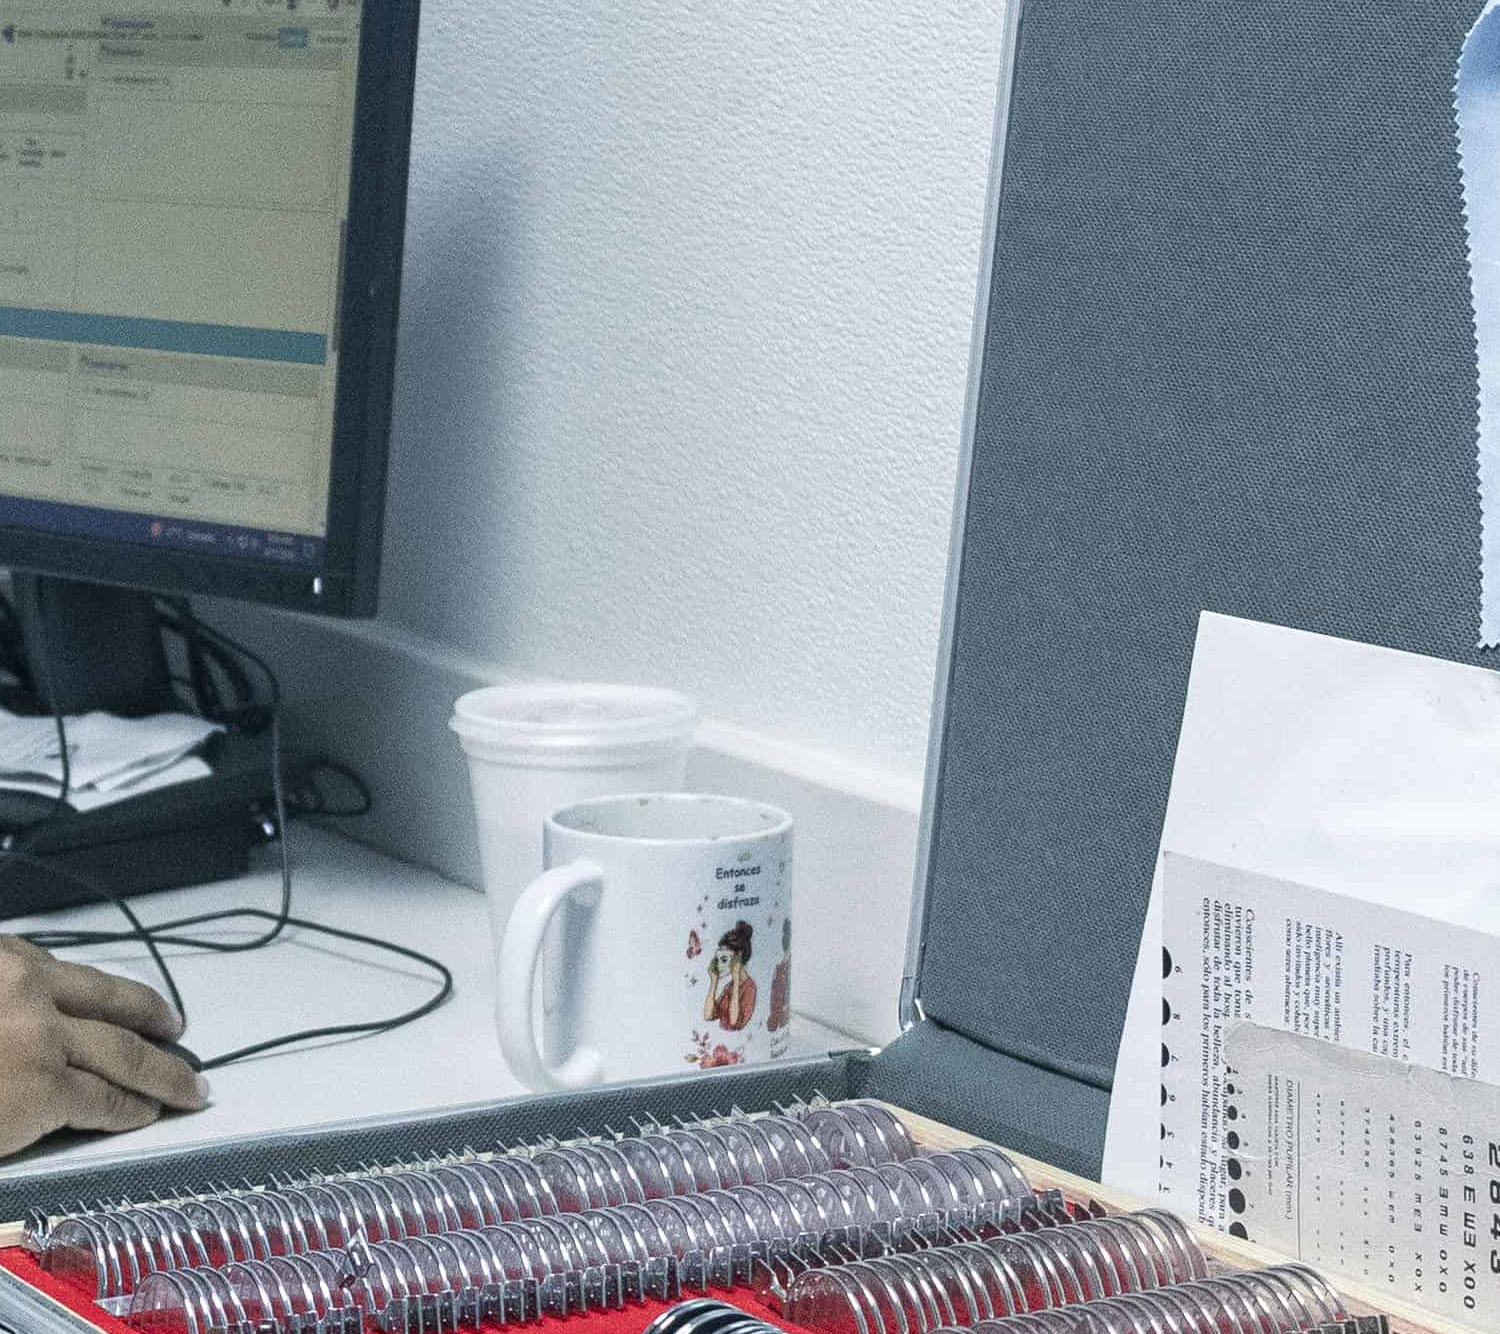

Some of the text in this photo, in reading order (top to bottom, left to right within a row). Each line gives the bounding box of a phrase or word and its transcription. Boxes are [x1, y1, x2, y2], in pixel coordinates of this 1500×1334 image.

[715, 865, 761, 880] Entonces
[734, 883, 745, 893] se
[1202, 897, 1211, 953] entonces,
[1213, 900, 1223, 951] disfrutar
[1224, 903, 1233, 971] eliminando
[1234, 906, 1242, 956] tuvieron
[1305, 924, 1313, 949] bello
[1325, 929, 1333, 957] flores
[1335, 932, 1343, 952] Allí
[1213, 956, 1223, 971] de
[1245, 909, 1255, 981] Conscientes
[1313, 927, 1323, 983] inteligencia
[1203, 957, 1211, 982] sólo
[1224, 976, 1232, 987] al
[1231, 960, 1241, 984] que
[1303, 951, 1312, 986] planeta
[1373, 944, 1381, 991] irradiaba
[1382, 947, 1392, 1003] profundos,
[1392, 950, 1401, 1018] temperaturas
[1201, 984, 1209, 1010] para
[1213, 976, 1222, 1002] toda
[1245, 989, 1254, 1004] de
[1312, 985, 1320, 1009] muy
[1334, 992, 1340, 1004] un
[1402, 953, 1412, 1049] Para entonces, el
[1213, 1008, 1222, 1019] la
[1372, 1025, 1381, 1035] la
[1200, 1033, 1209, 1087] primeros
[1212, 1024, 1222, 1069] belleza,
[1201, 1089, 1211, 1129] habían
[1211, 1075, 1222, 1142] abundancia
[1285, 1079, 1294, 1139] DIAMETRO
[1200, 1131, 1209, 1170] estado
[1209, 1147, 1217, 1157] y
[1285, 1140, 1294, 1188] PUPILAR
[1206, 1160, 1219, 1211] placeres
